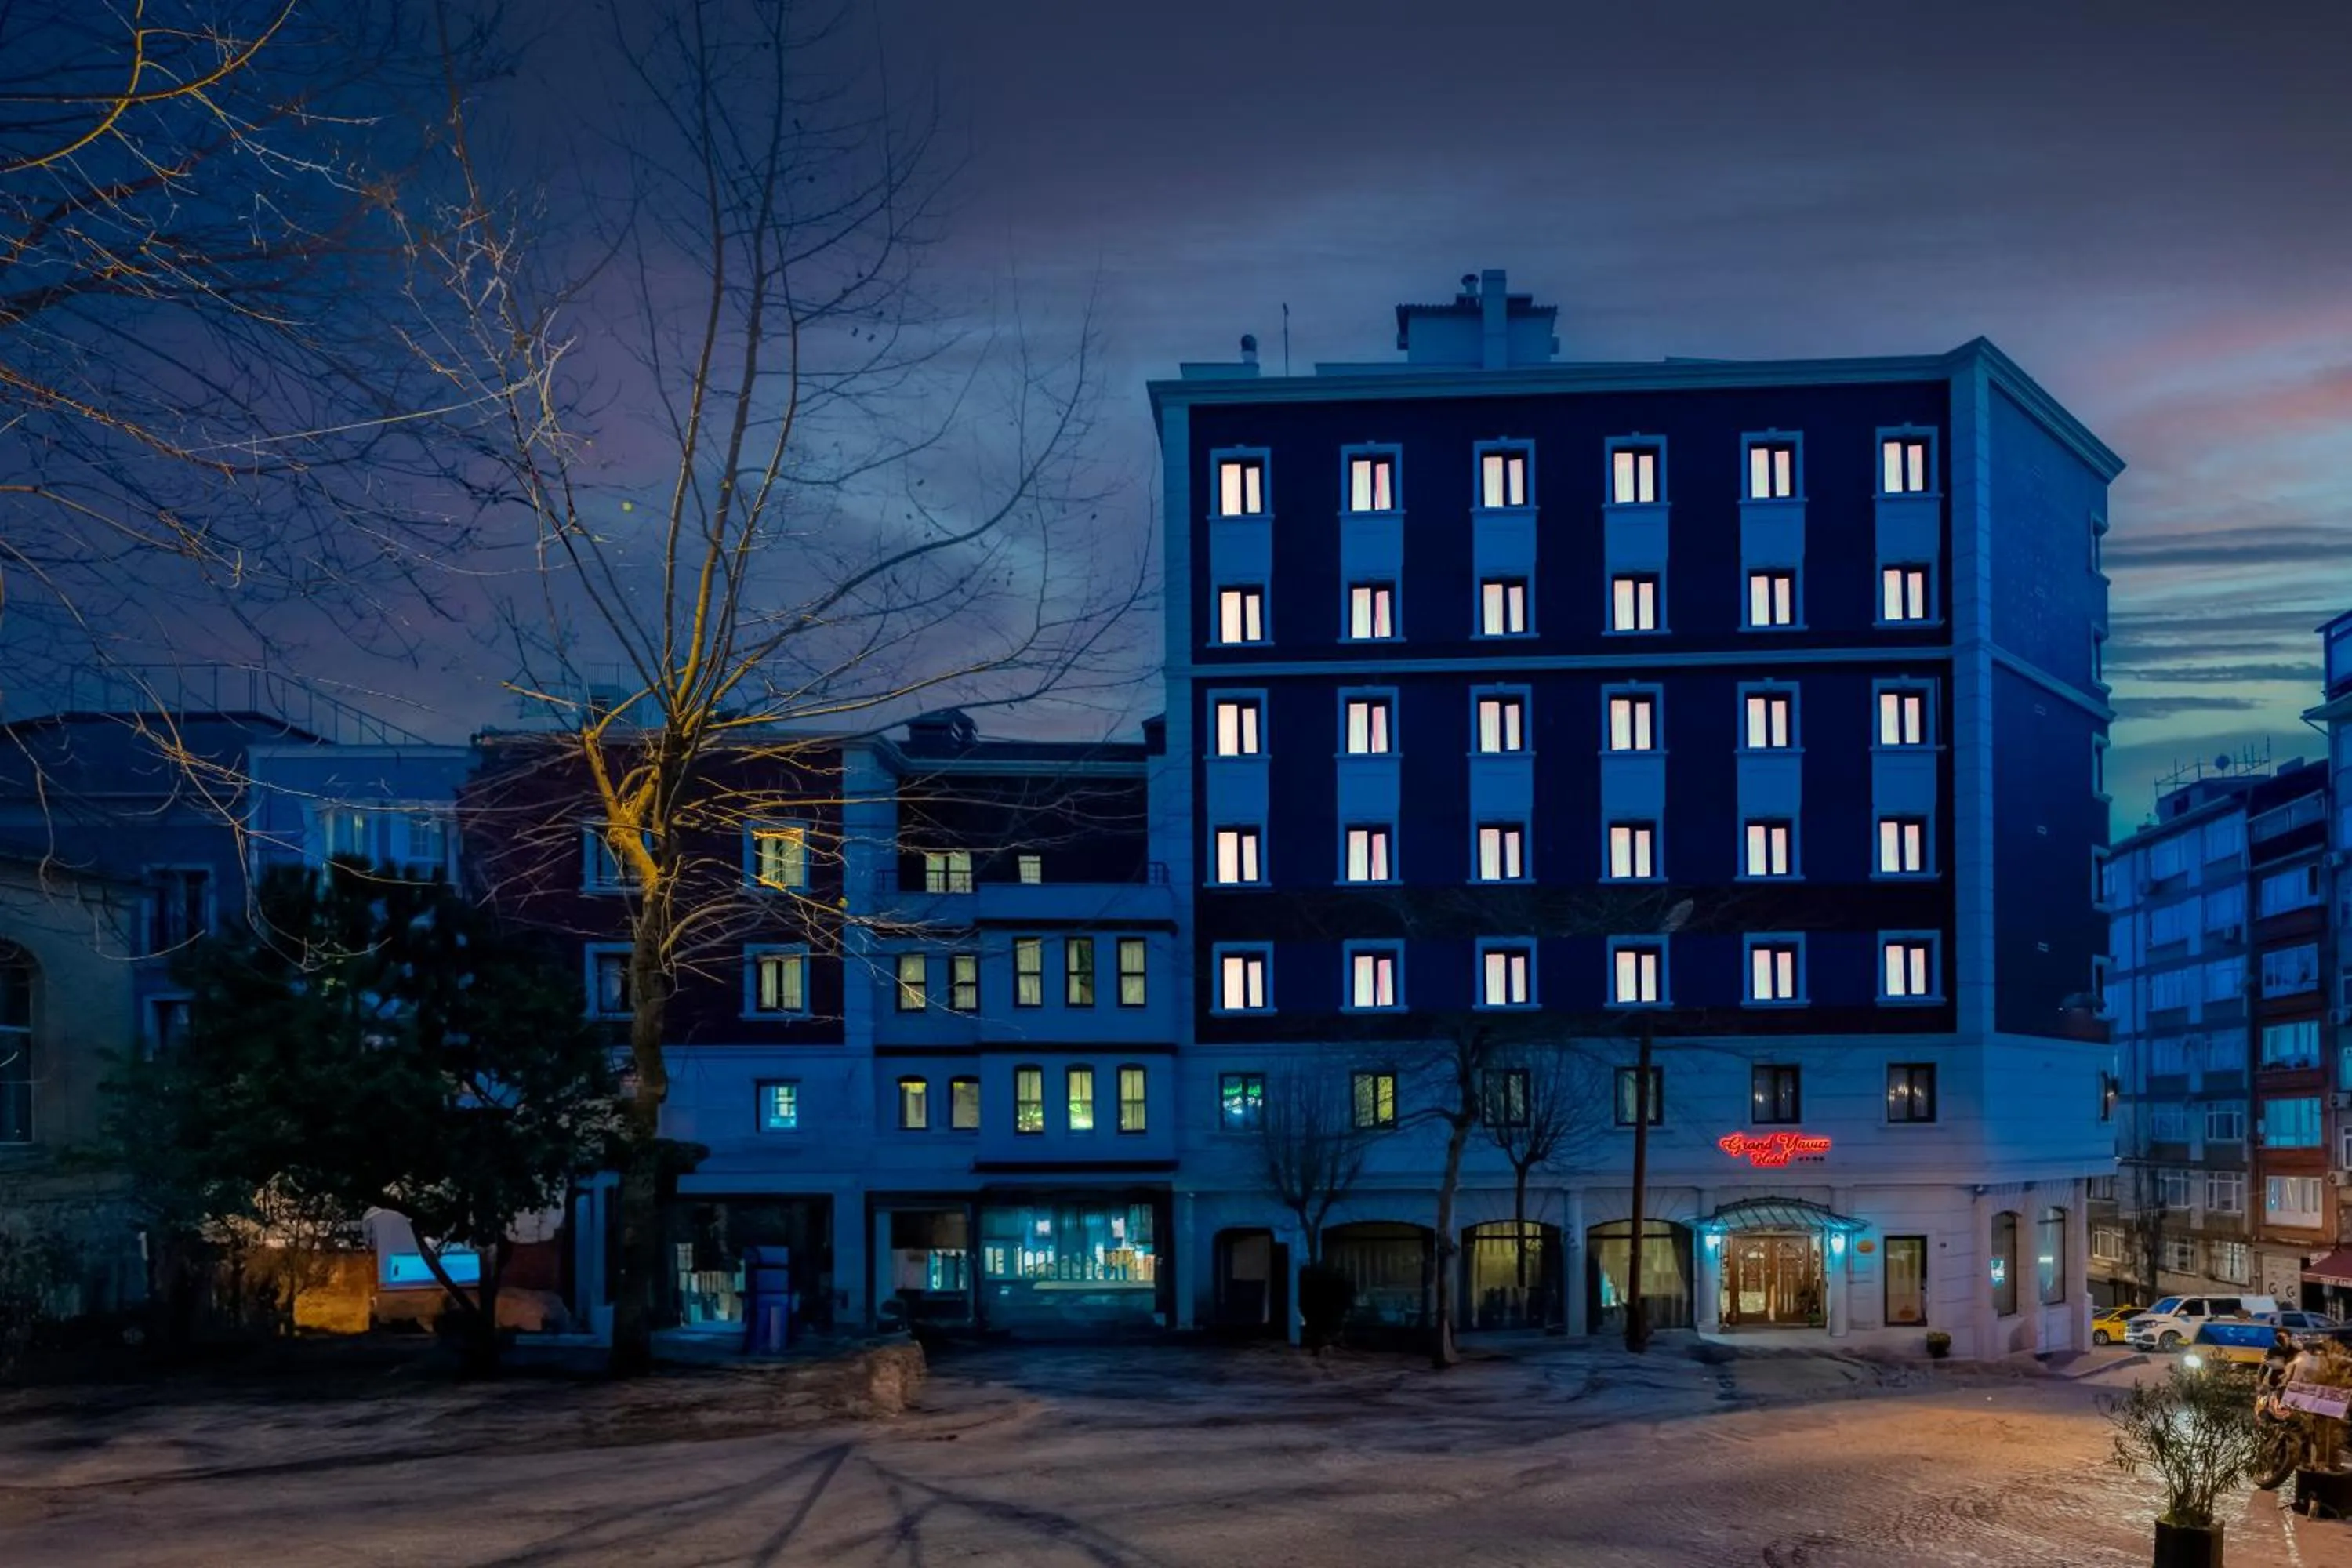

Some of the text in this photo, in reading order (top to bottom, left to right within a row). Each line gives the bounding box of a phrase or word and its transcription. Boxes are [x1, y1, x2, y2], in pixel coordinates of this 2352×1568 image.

[1720, 1134, 1830, 1156] Grand Yavuz
[1751, 1152, 1789, 1165] Hotel
